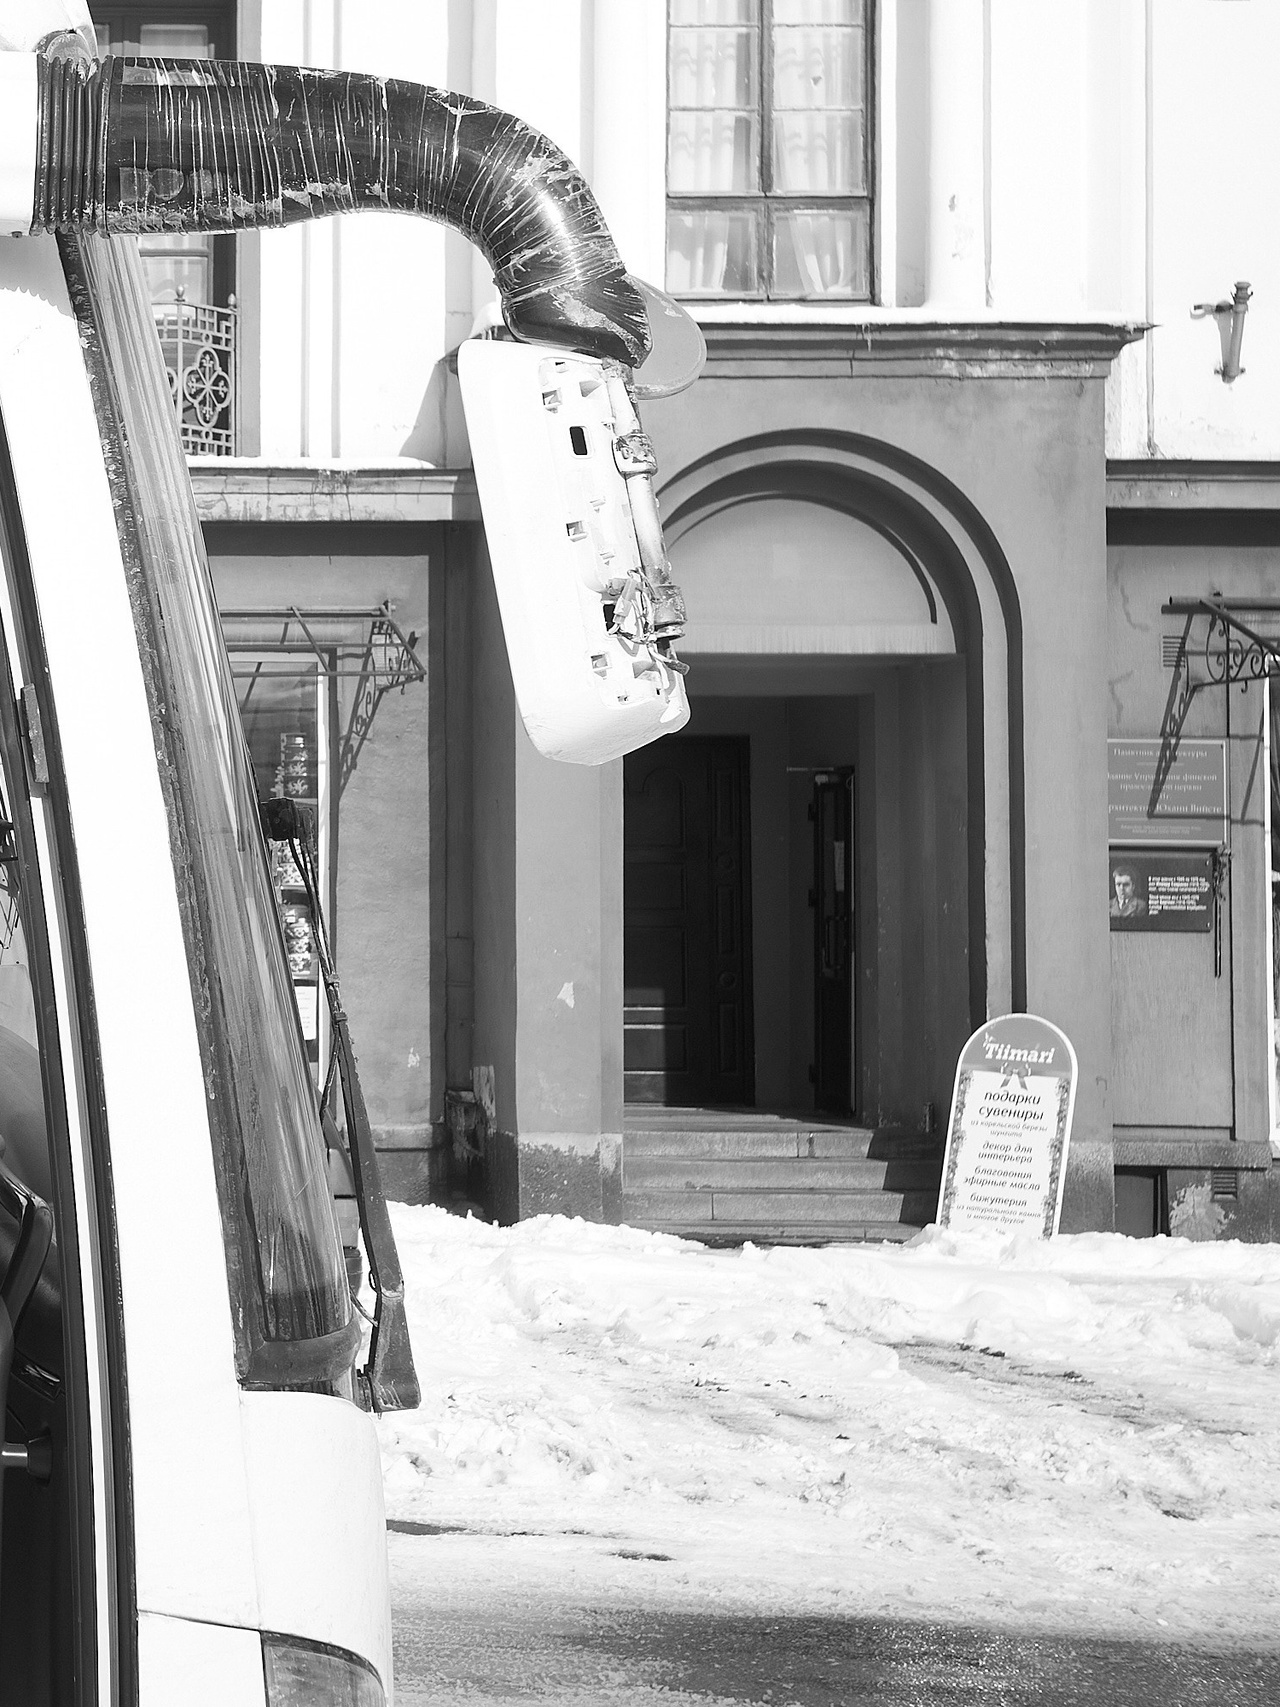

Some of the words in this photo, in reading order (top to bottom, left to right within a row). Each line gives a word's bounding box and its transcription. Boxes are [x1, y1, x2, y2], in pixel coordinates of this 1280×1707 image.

[984, 1042, 1055, 1064] Tiimari
[984, 1090, 1041, 1106] подарки
[978, 1105, 1044, 1121] сувениры
[982, 1140, 1012, 1153] декор
[1014, 1143, 1033, 1154] для
[978, 1151, 1033, 1165] интерьера
[974, 1165, 1032, 1180] благовония
[963, 1176, 1007, 1188] эфирные
[1009, 1182, 1041, 1191] масла
[969, 1192, 1028, 1207] бижутерия
